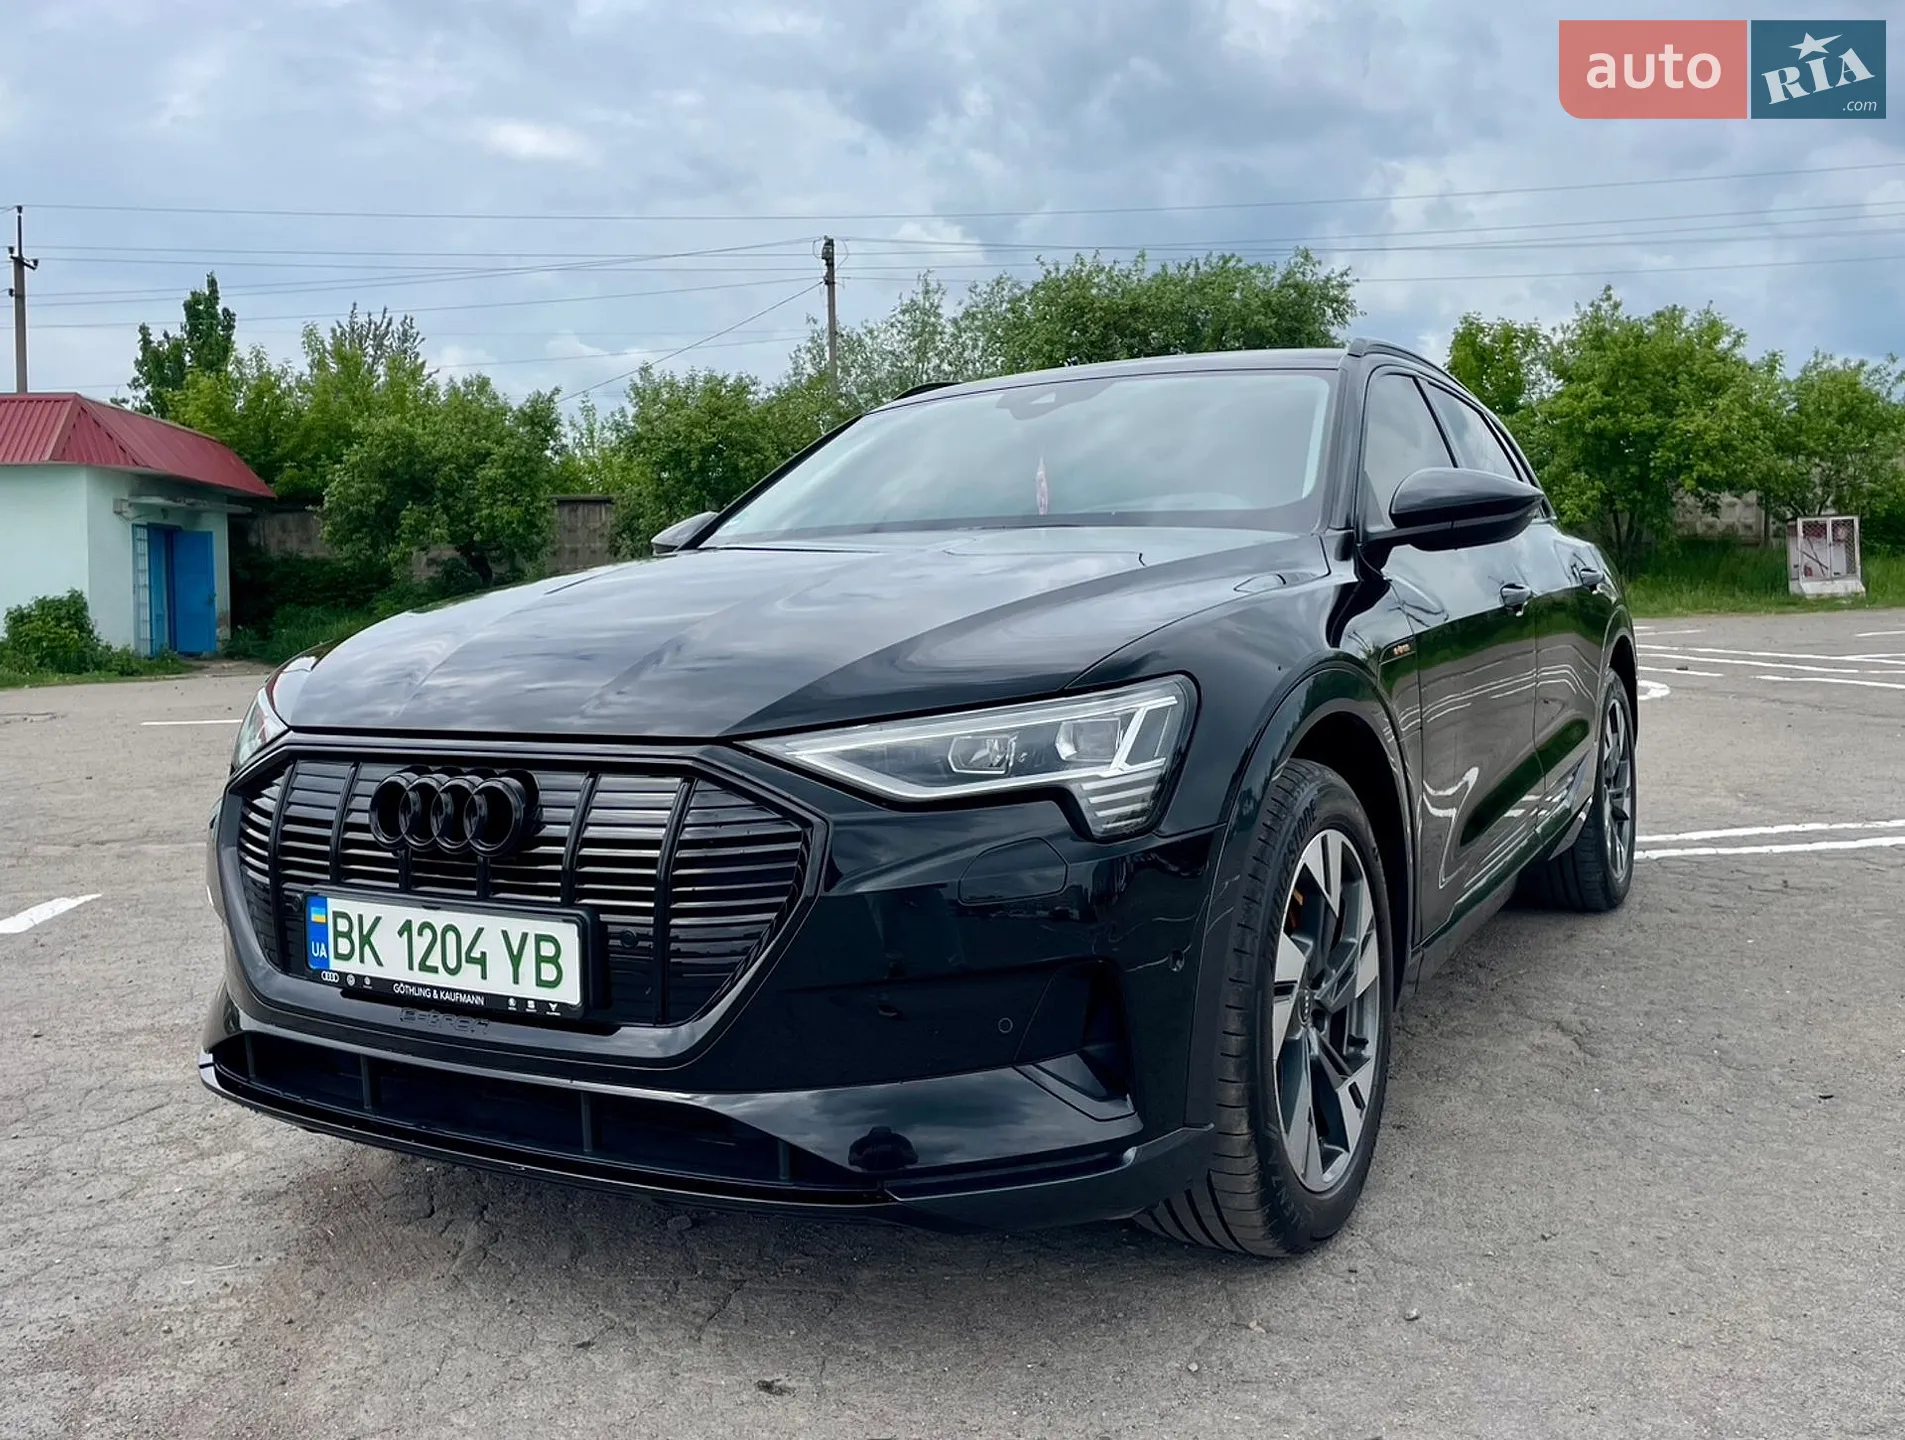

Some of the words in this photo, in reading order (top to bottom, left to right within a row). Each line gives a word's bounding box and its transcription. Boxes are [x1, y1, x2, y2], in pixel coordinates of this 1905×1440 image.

[311, 941, 328, 959] UA
[331, 910, 384, 967] BK
[397, 919, 488, 981] 1204
[501, 929, 564, 989] YB
[432, 989, 439, 999] &
[439, 990, 485, 1006] KAUFMANN
